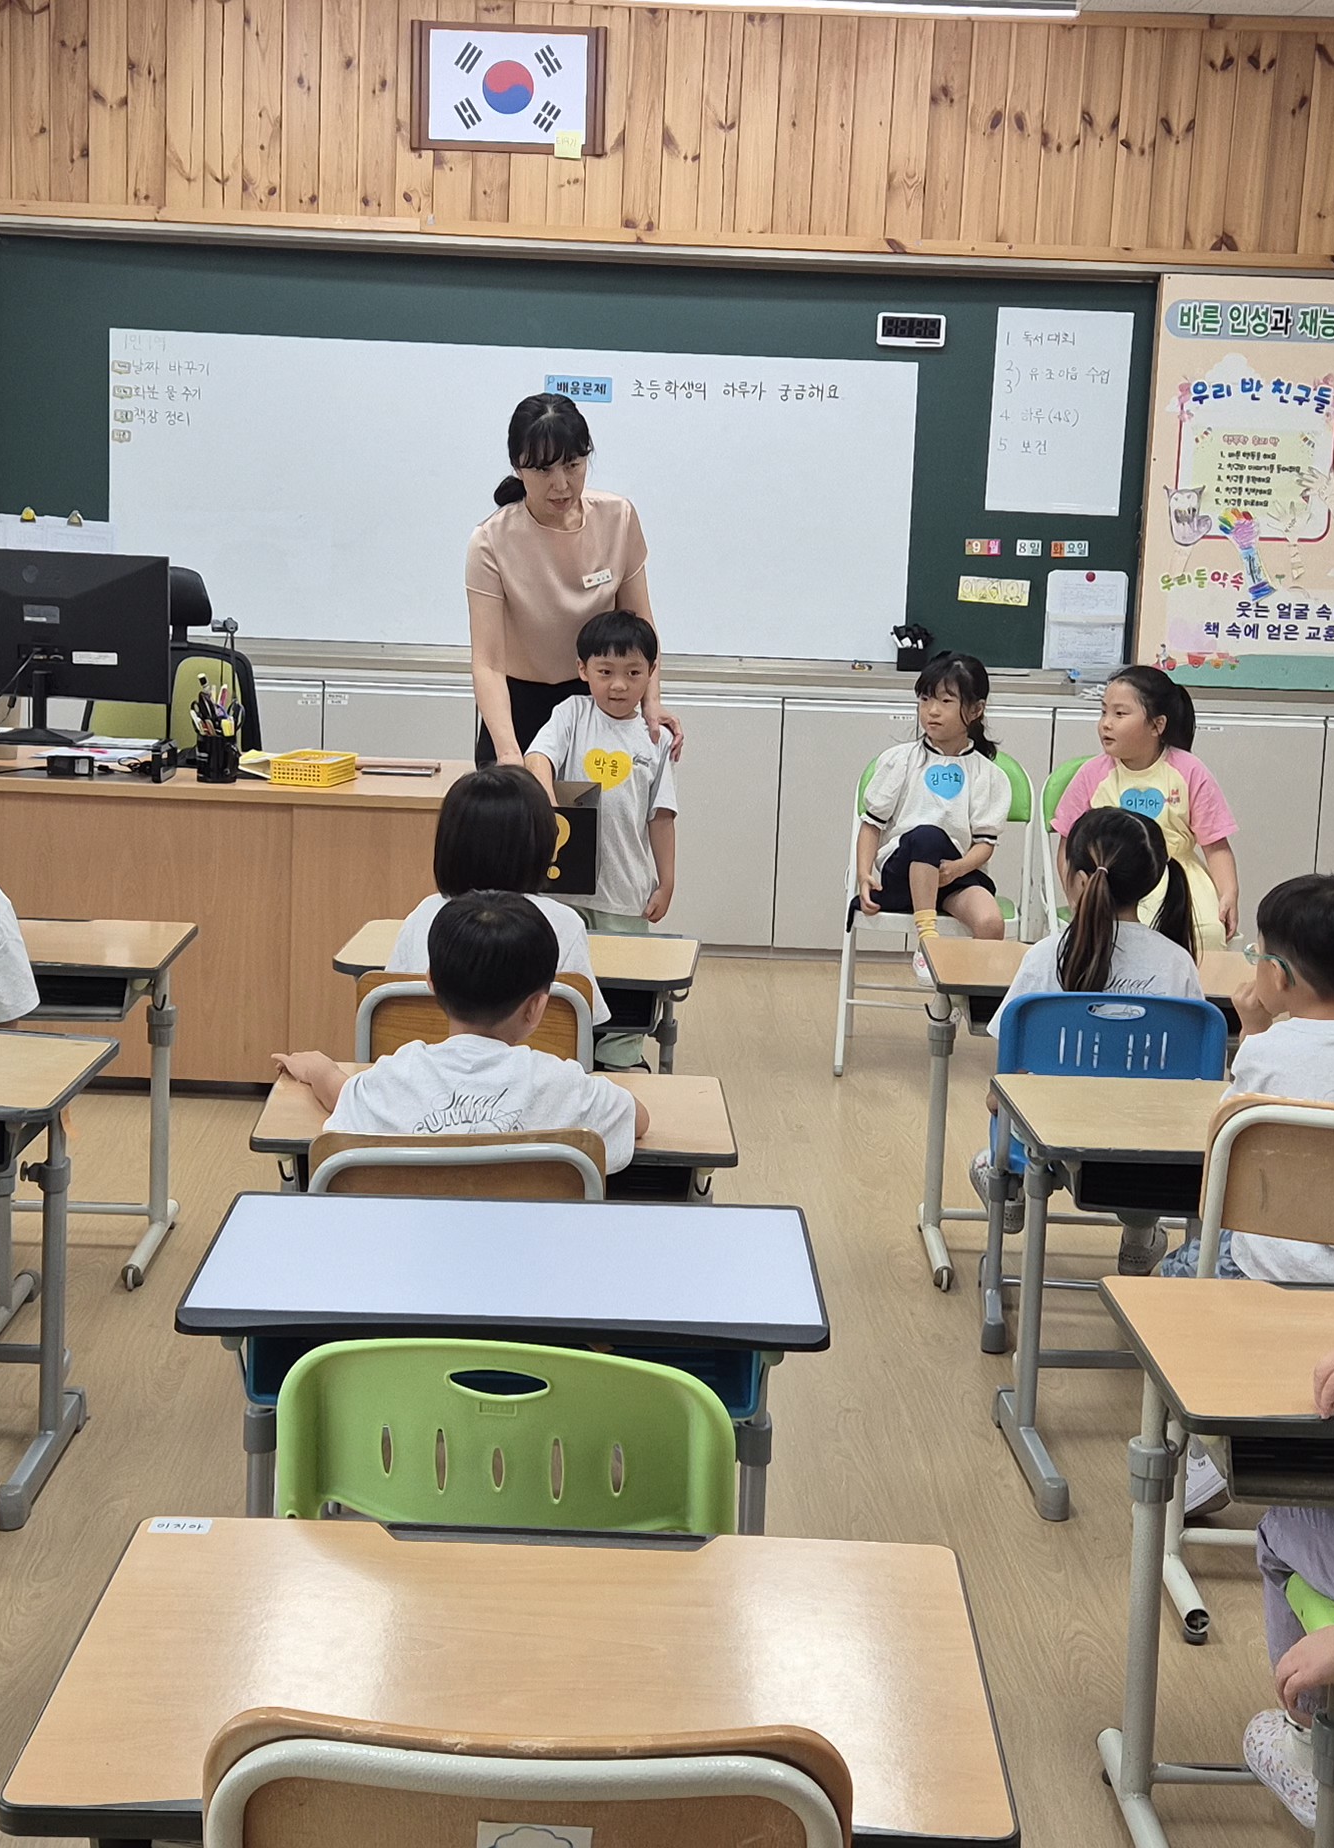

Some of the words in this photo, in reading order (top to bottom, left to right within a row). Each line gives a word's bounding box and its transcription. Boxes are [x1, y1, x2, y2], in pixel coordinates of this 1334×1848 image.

[1178, 303, 1221, 333] 바른
[1228, 305, 1292, 336] 인성과
[1023, 331, 1043, 347] 독서
[168, 360, 210, 376] 바꾸기
[556, 380, 607, 395] 배움문제
[631, 378, 707, 401] 초등학생의
[722, 379, 767, 401] 하루가
[778, 382, 840, 402] 궁금해요
[1191, 381, 1233, 405] 우리
[1240, 378, 1264, 401] 반
[1271, 378, 1332, 414] 친구들
[166, 410, 190, 427] 정리
[1020, 440, 1047, 455] 보건
[1236, 601, 1271, 619] 웃는
[1276, 602, 1311, 620] 얼굴
[1204, 621, 1220, 639] 책
[1225, 622, 1260, 641] 속에
[1266, 624, 1300, 641] 얻은
[1125, 797, 1160, 810] 이지아
